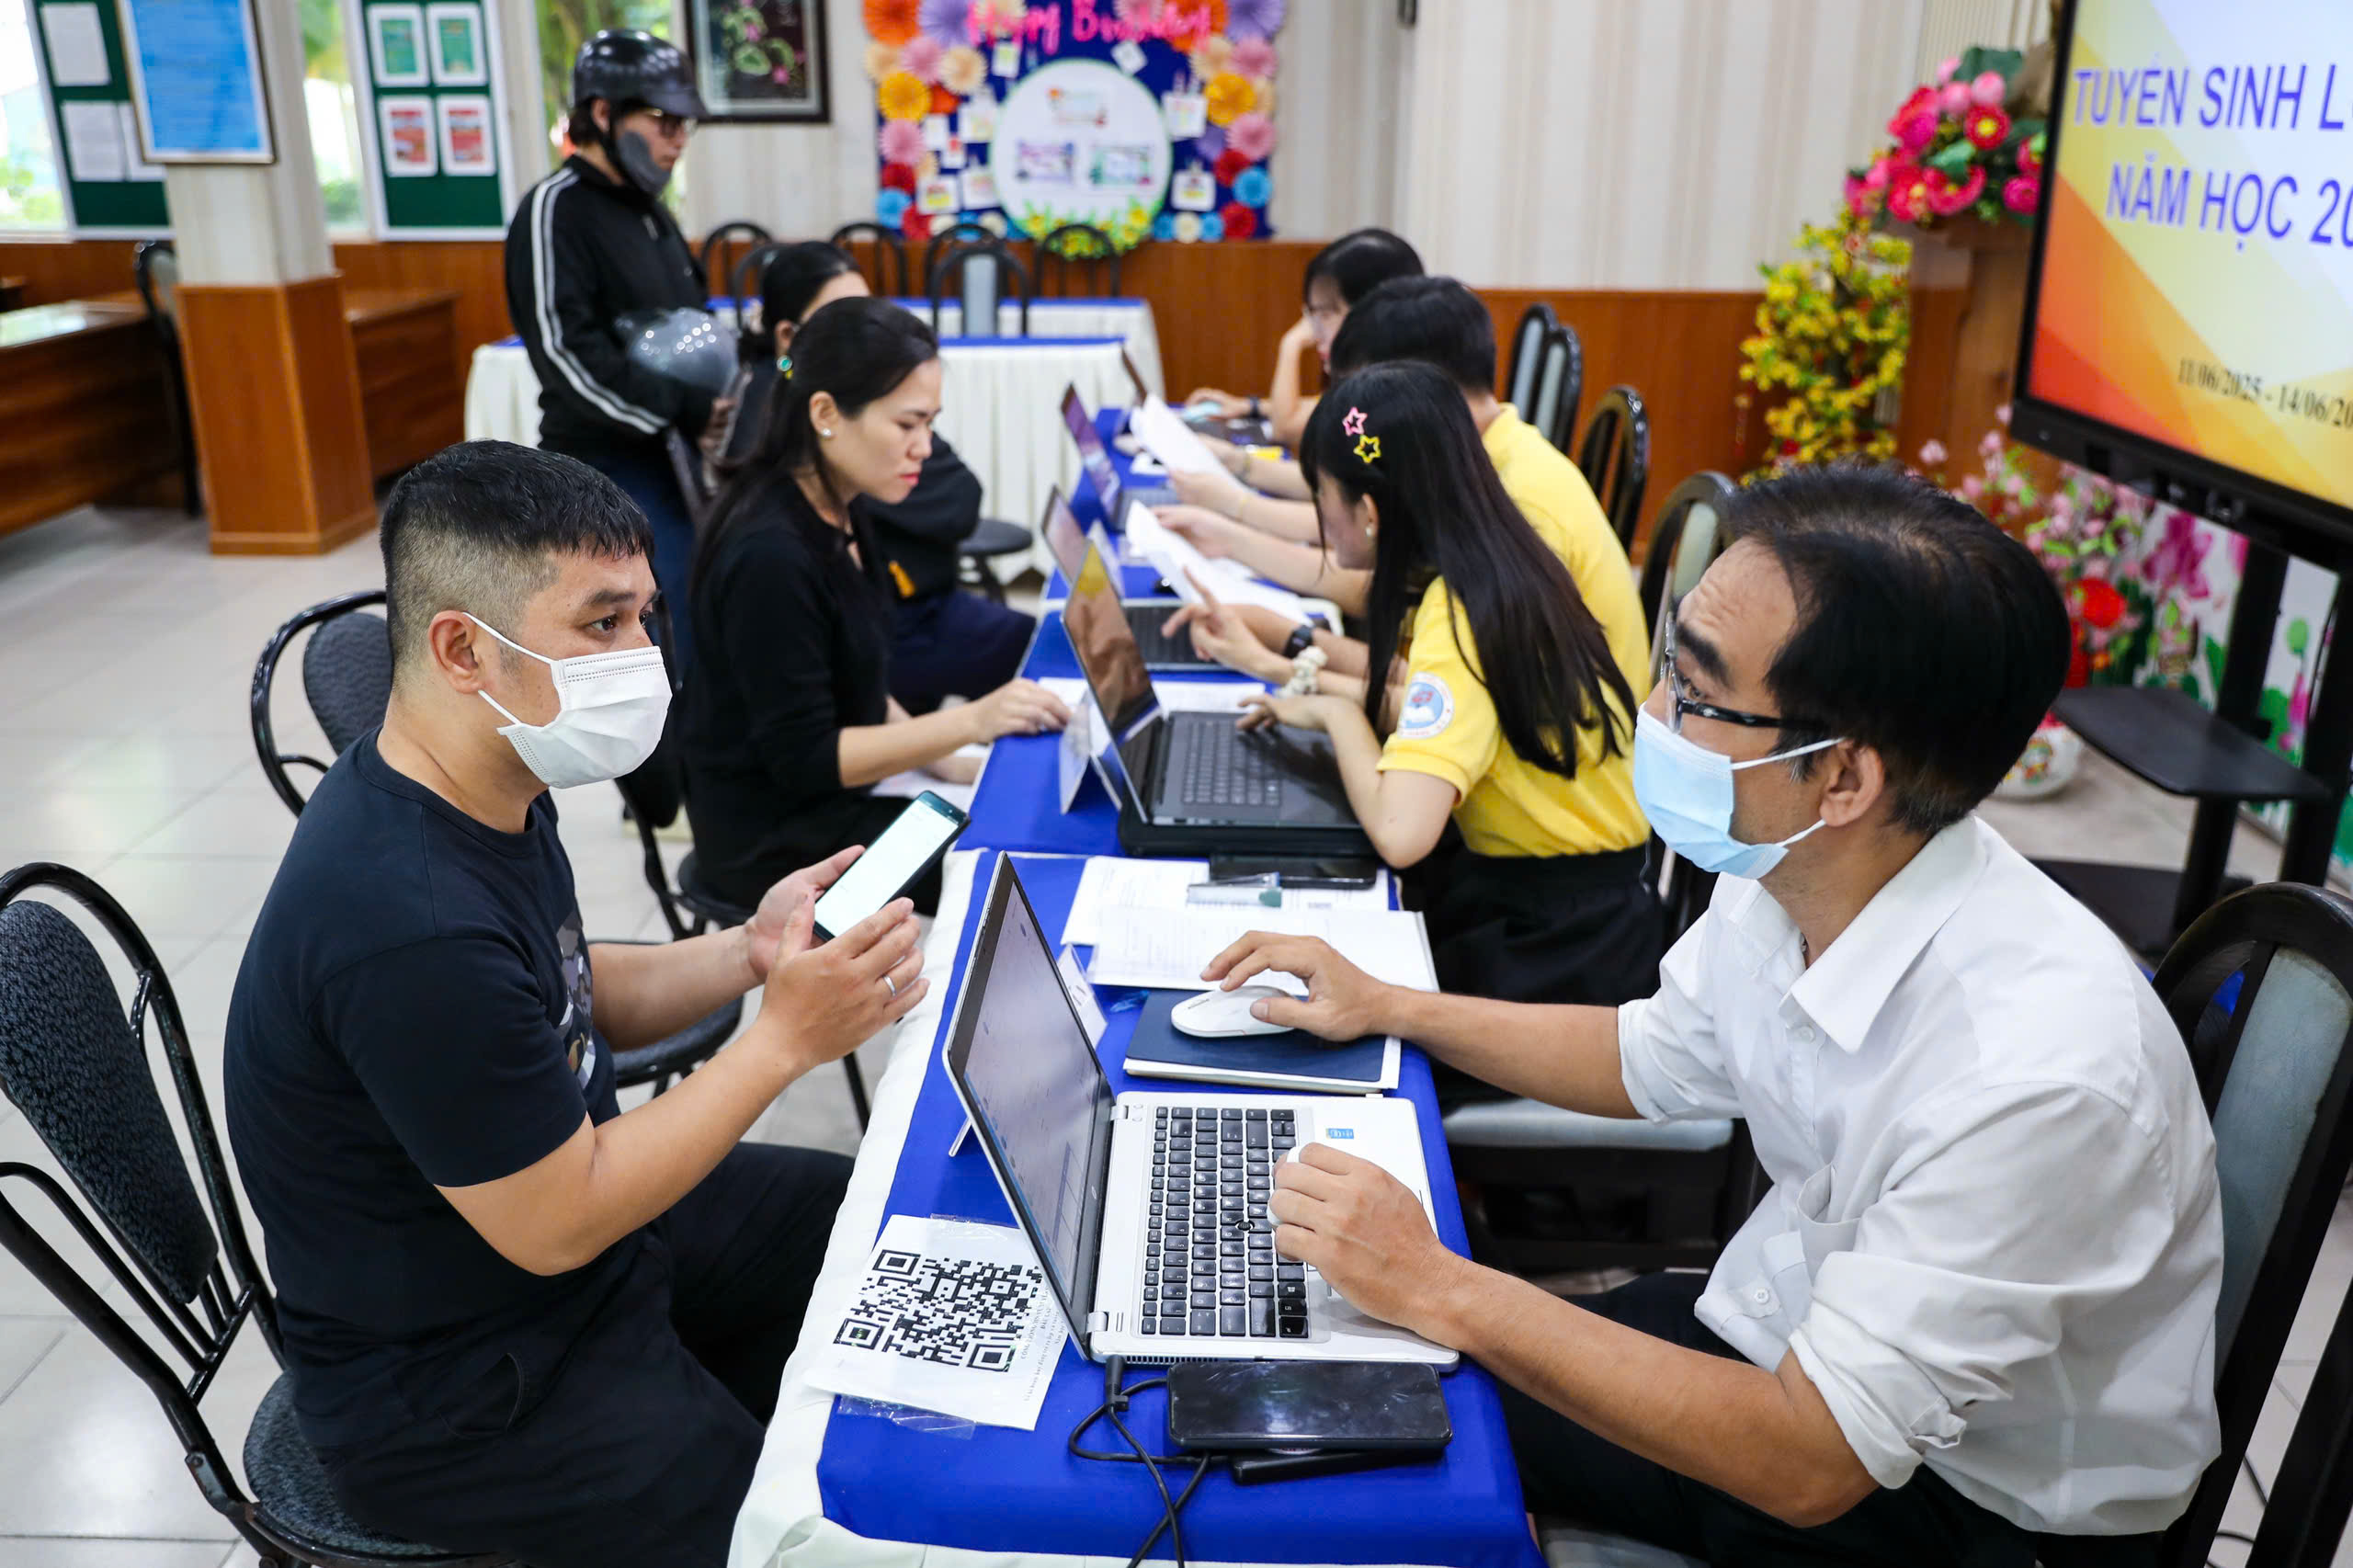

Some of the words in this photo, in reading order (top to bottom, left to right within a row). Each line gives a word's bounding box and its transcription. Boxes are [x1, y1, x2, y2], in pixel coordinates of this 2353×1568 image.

[2200, 63, 2307, 131] SINH
[2318, 63, 2353, 131] L
[2107, 153, 2191, 227] NĂM
[2200, 171, 2298, 252] HỌC
